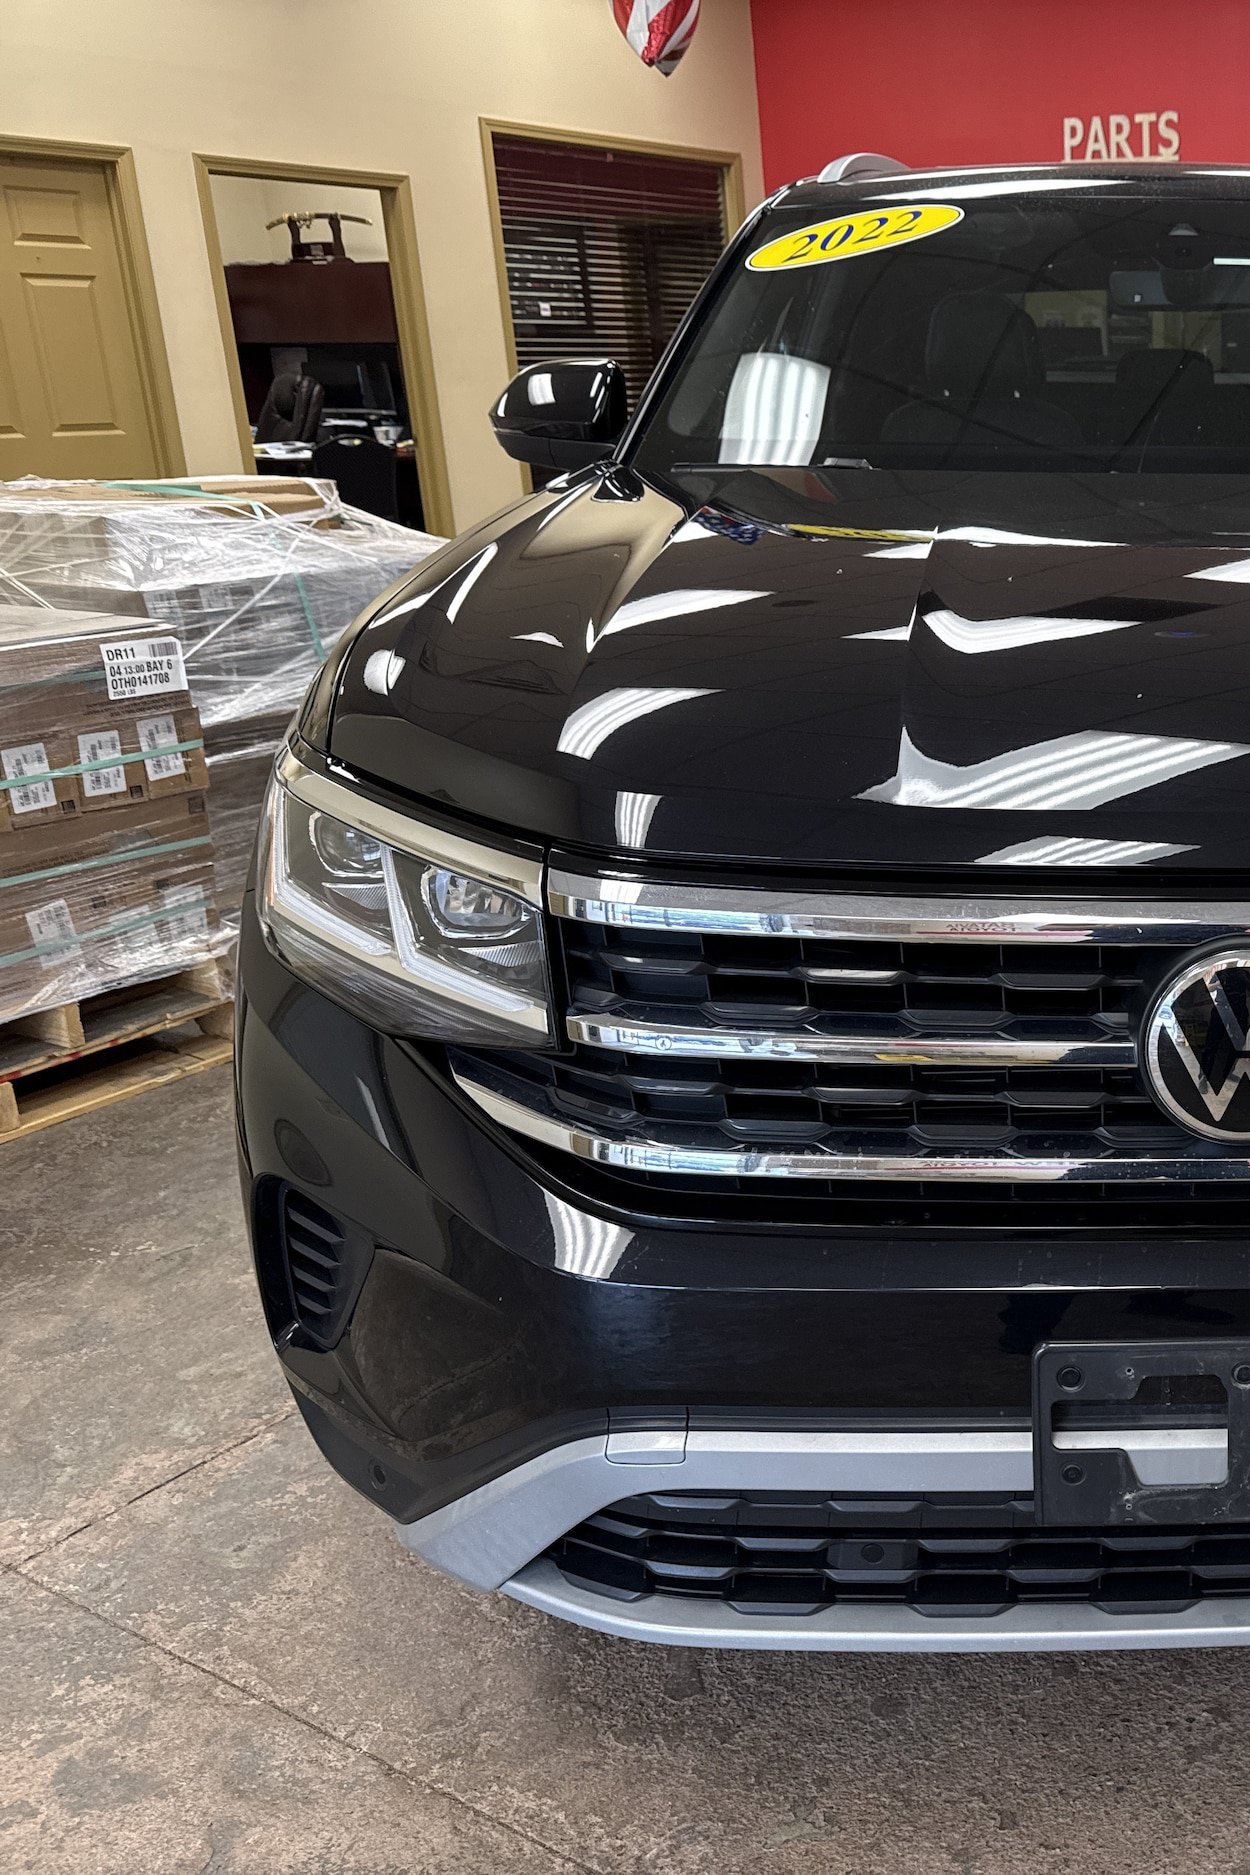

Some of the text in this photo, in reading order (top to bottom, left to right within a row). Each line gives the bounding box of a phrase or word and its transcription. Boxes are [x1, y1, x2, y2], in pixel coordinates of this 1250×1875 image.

[1062, 109, 1180, 162] PARTS
[781, 210, 922, 263] 2022
[106, 647, 136, 660] DR11
[110, 665, 122, 678] 04
[146, 660, 164, 672] BAY
[166, 658, 172, 670] 6
